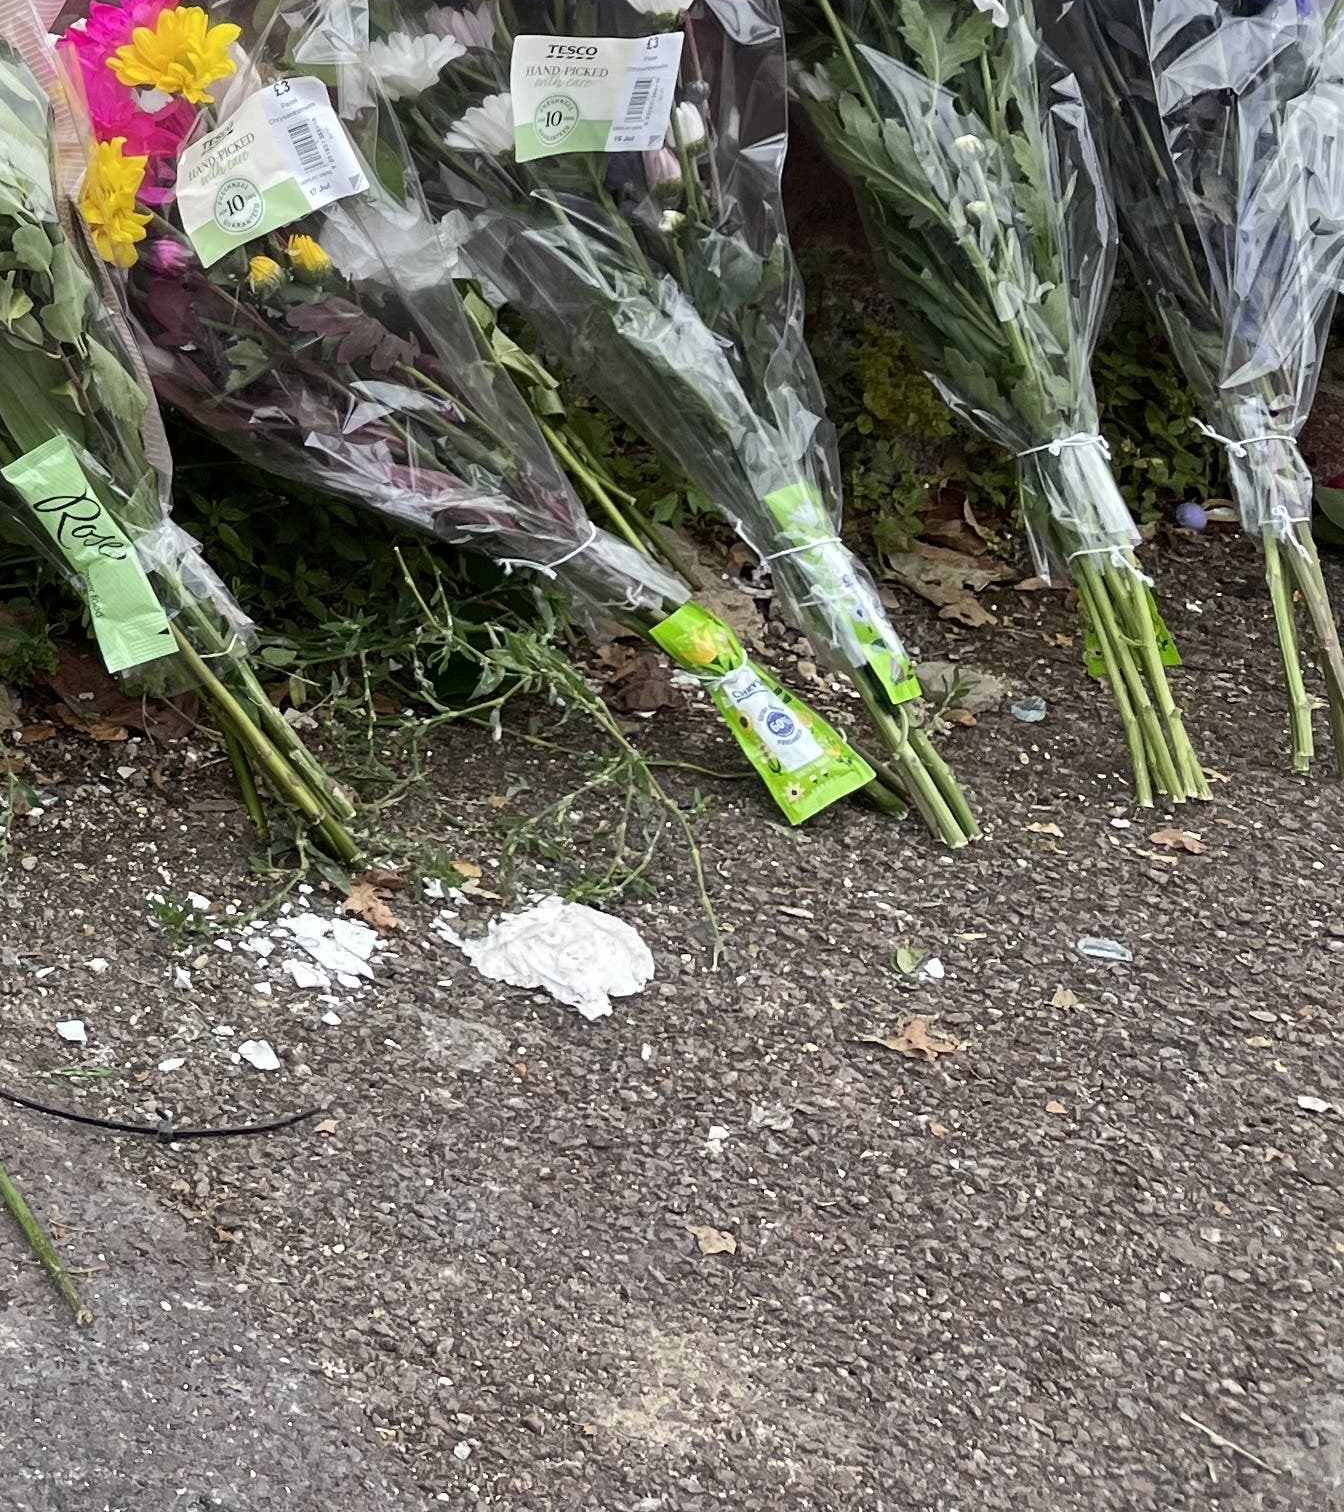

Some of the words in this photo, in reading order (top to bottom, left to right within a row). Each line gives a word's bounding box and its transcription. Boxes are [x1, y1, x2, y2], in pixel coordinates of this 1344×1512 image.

[547, 44, 598, 57] TESCO
[646, 36, 659, 50] £3
[273, 80, 291, 96] £3
[545, 110, 563, 128] 10
[201, 121, 234, 152] TESCO
[226, 194, 245, 217] 10
